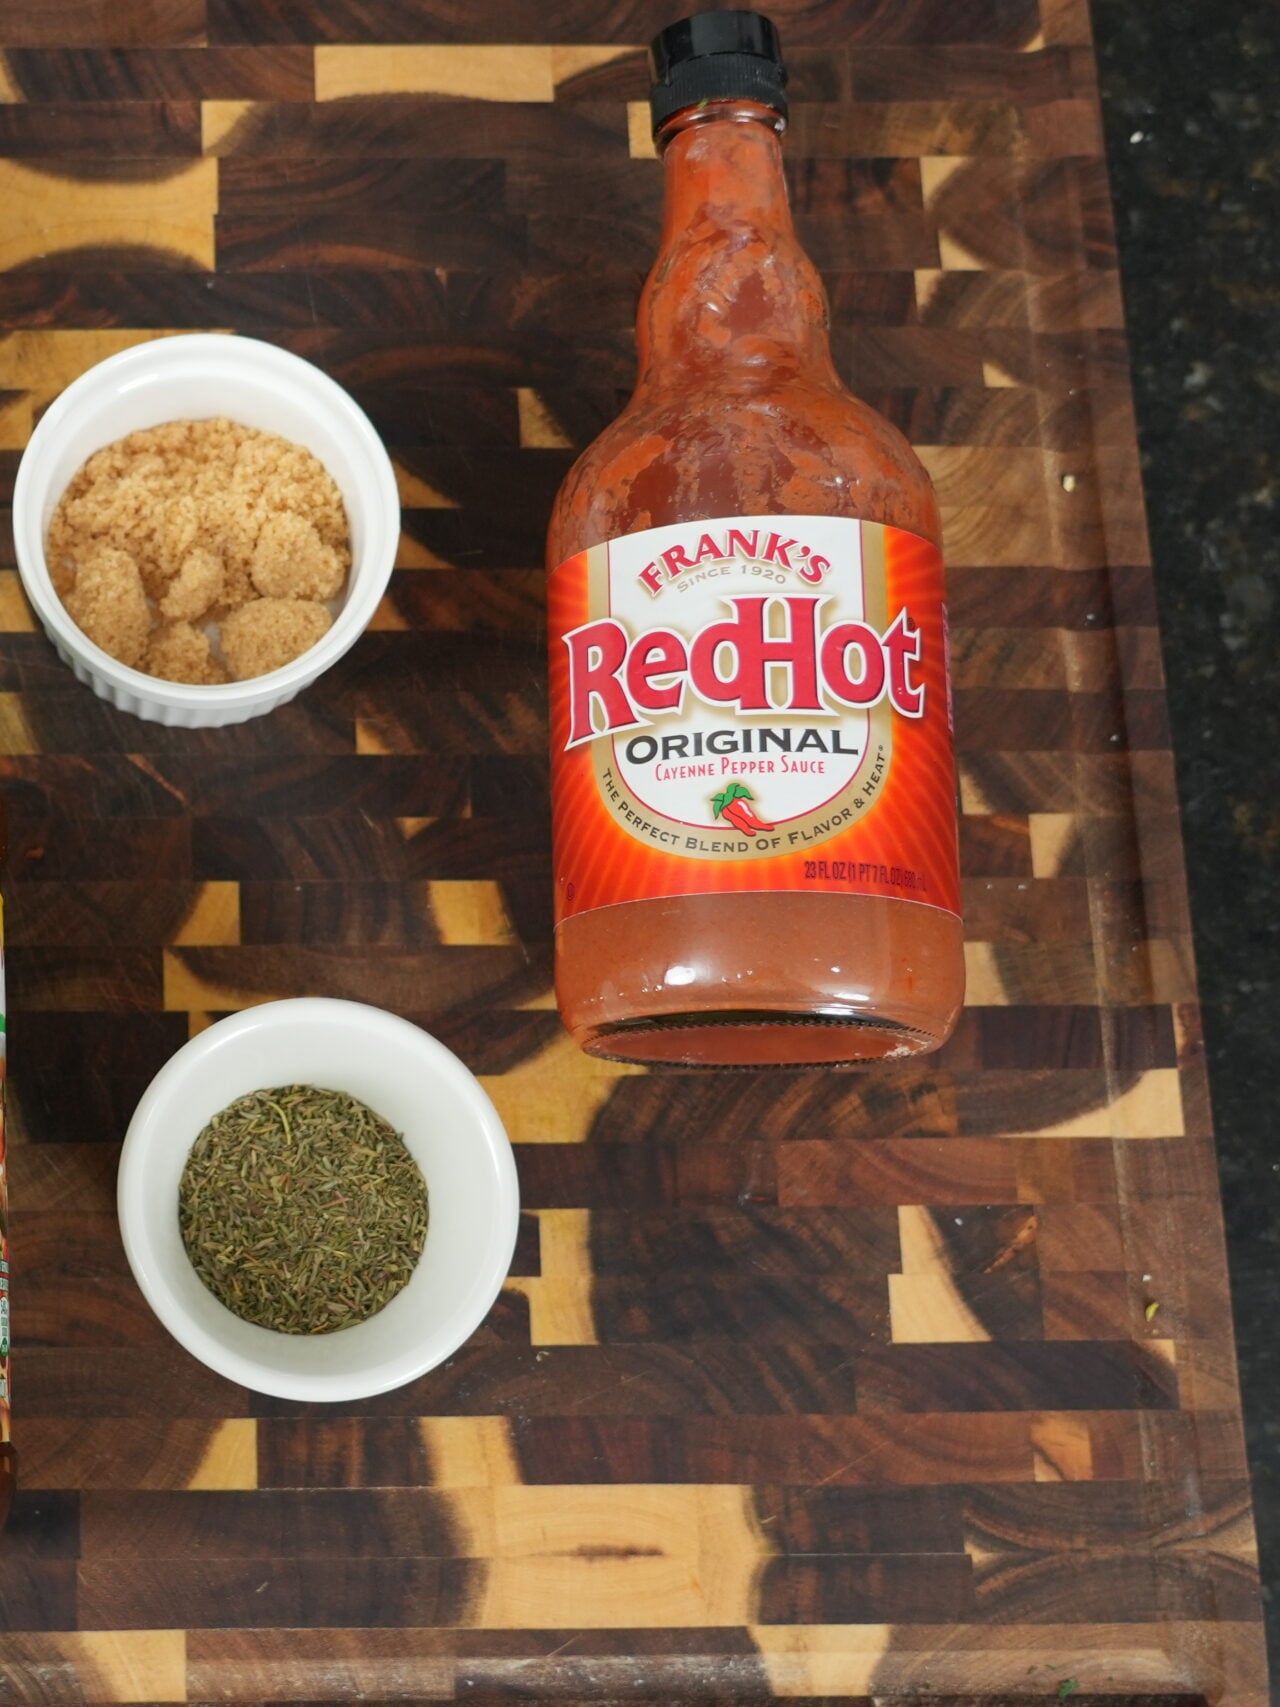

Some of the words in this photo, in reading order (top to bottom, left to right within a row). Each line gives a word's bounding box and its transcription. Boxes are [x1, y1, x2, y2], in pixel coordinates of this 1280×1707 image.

[637, 528, 831, 596] FRANK'S
[676, 566, 732, 592] SINCE
[740, 564, 788, 585] 1920
[561, 592, 925, 752] RedHot
[625, 728, 859, 765] ORIGINAL
[602, 768, 620, 800] THE
[617, 803, 681, 846] PERFECT
[685, 836, 749, 853] BLEND
[755, 837, 781, 852] OF
[787, 808, 854, 846] FLAVOR
[854, 798, 866, 810] &
[804, 861, 817, 879] 23
[818, 861, 831, 879] FL
[832, 862, 846, 880] OZ
[859, 863, 871, 882] PT
